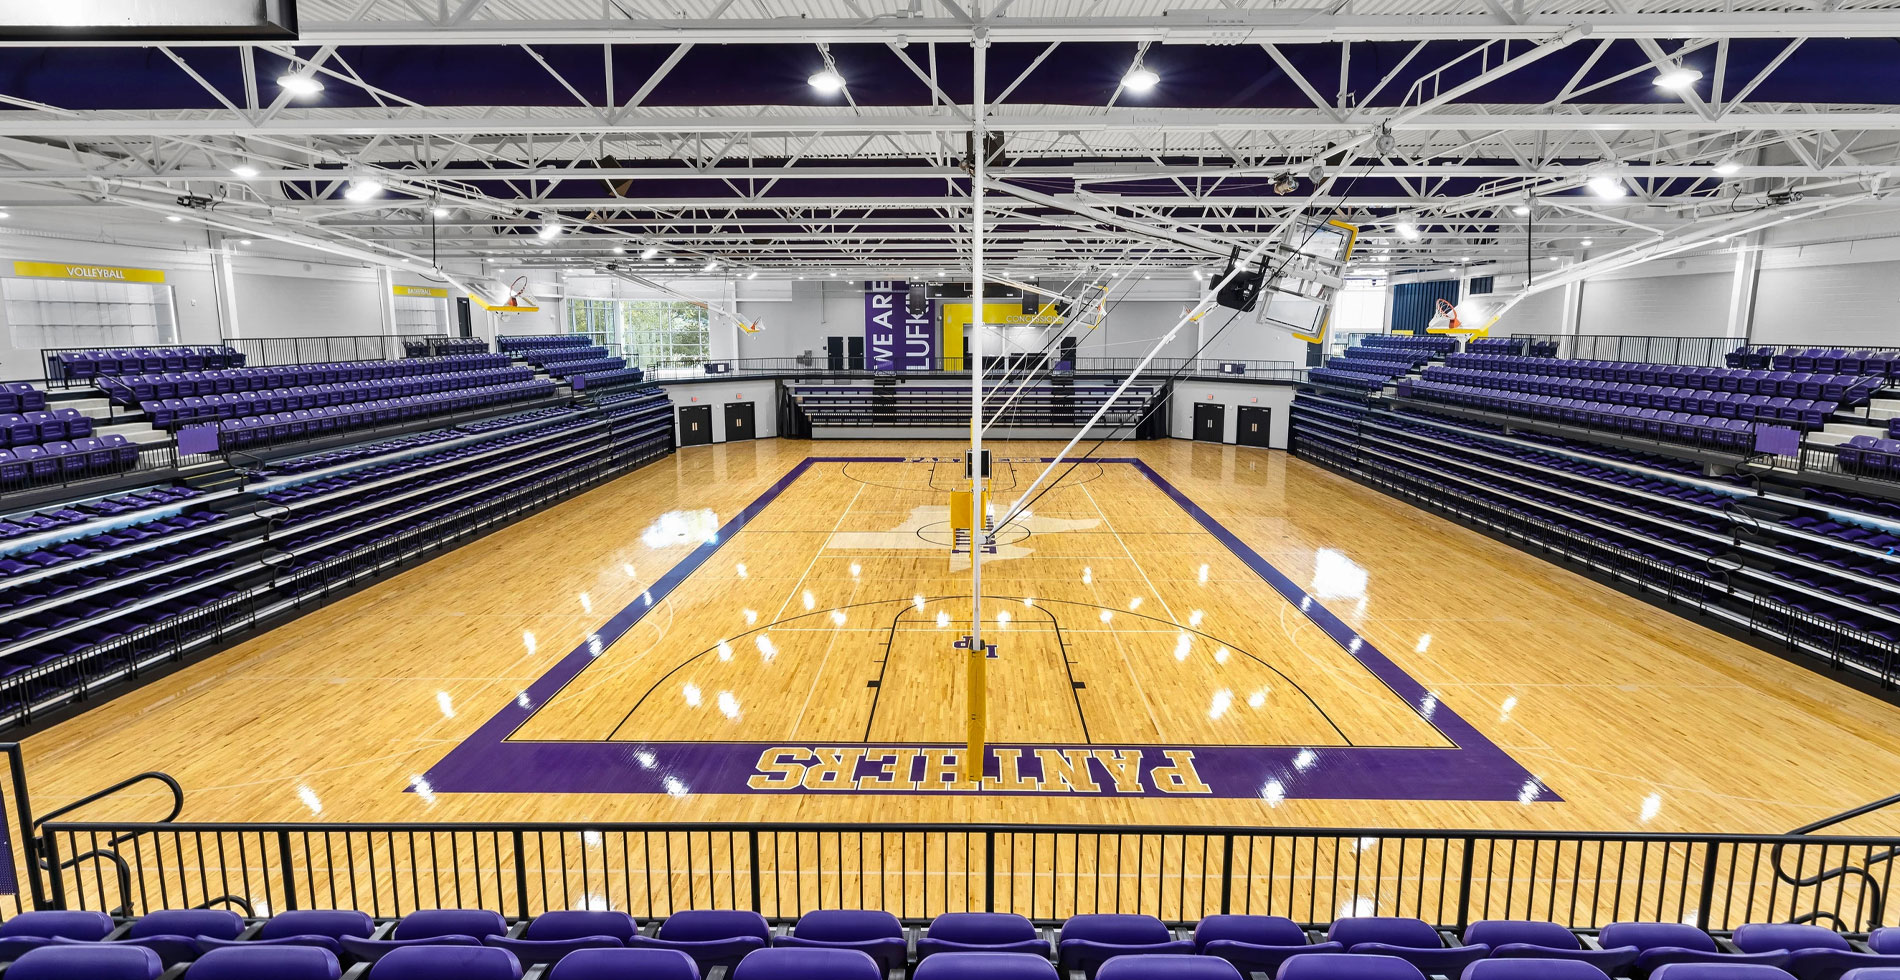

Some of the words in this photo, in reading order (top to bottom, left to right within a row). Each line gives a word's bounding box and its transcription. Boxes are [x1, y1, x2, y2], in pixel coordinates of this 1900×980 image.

[66, 265, 125, 279] VOLLEYBALL
[873, 281, 893, 329] ARE
[873, 334, 893, 370] WE
[746, 747, 1213, 794] PANTHERS
